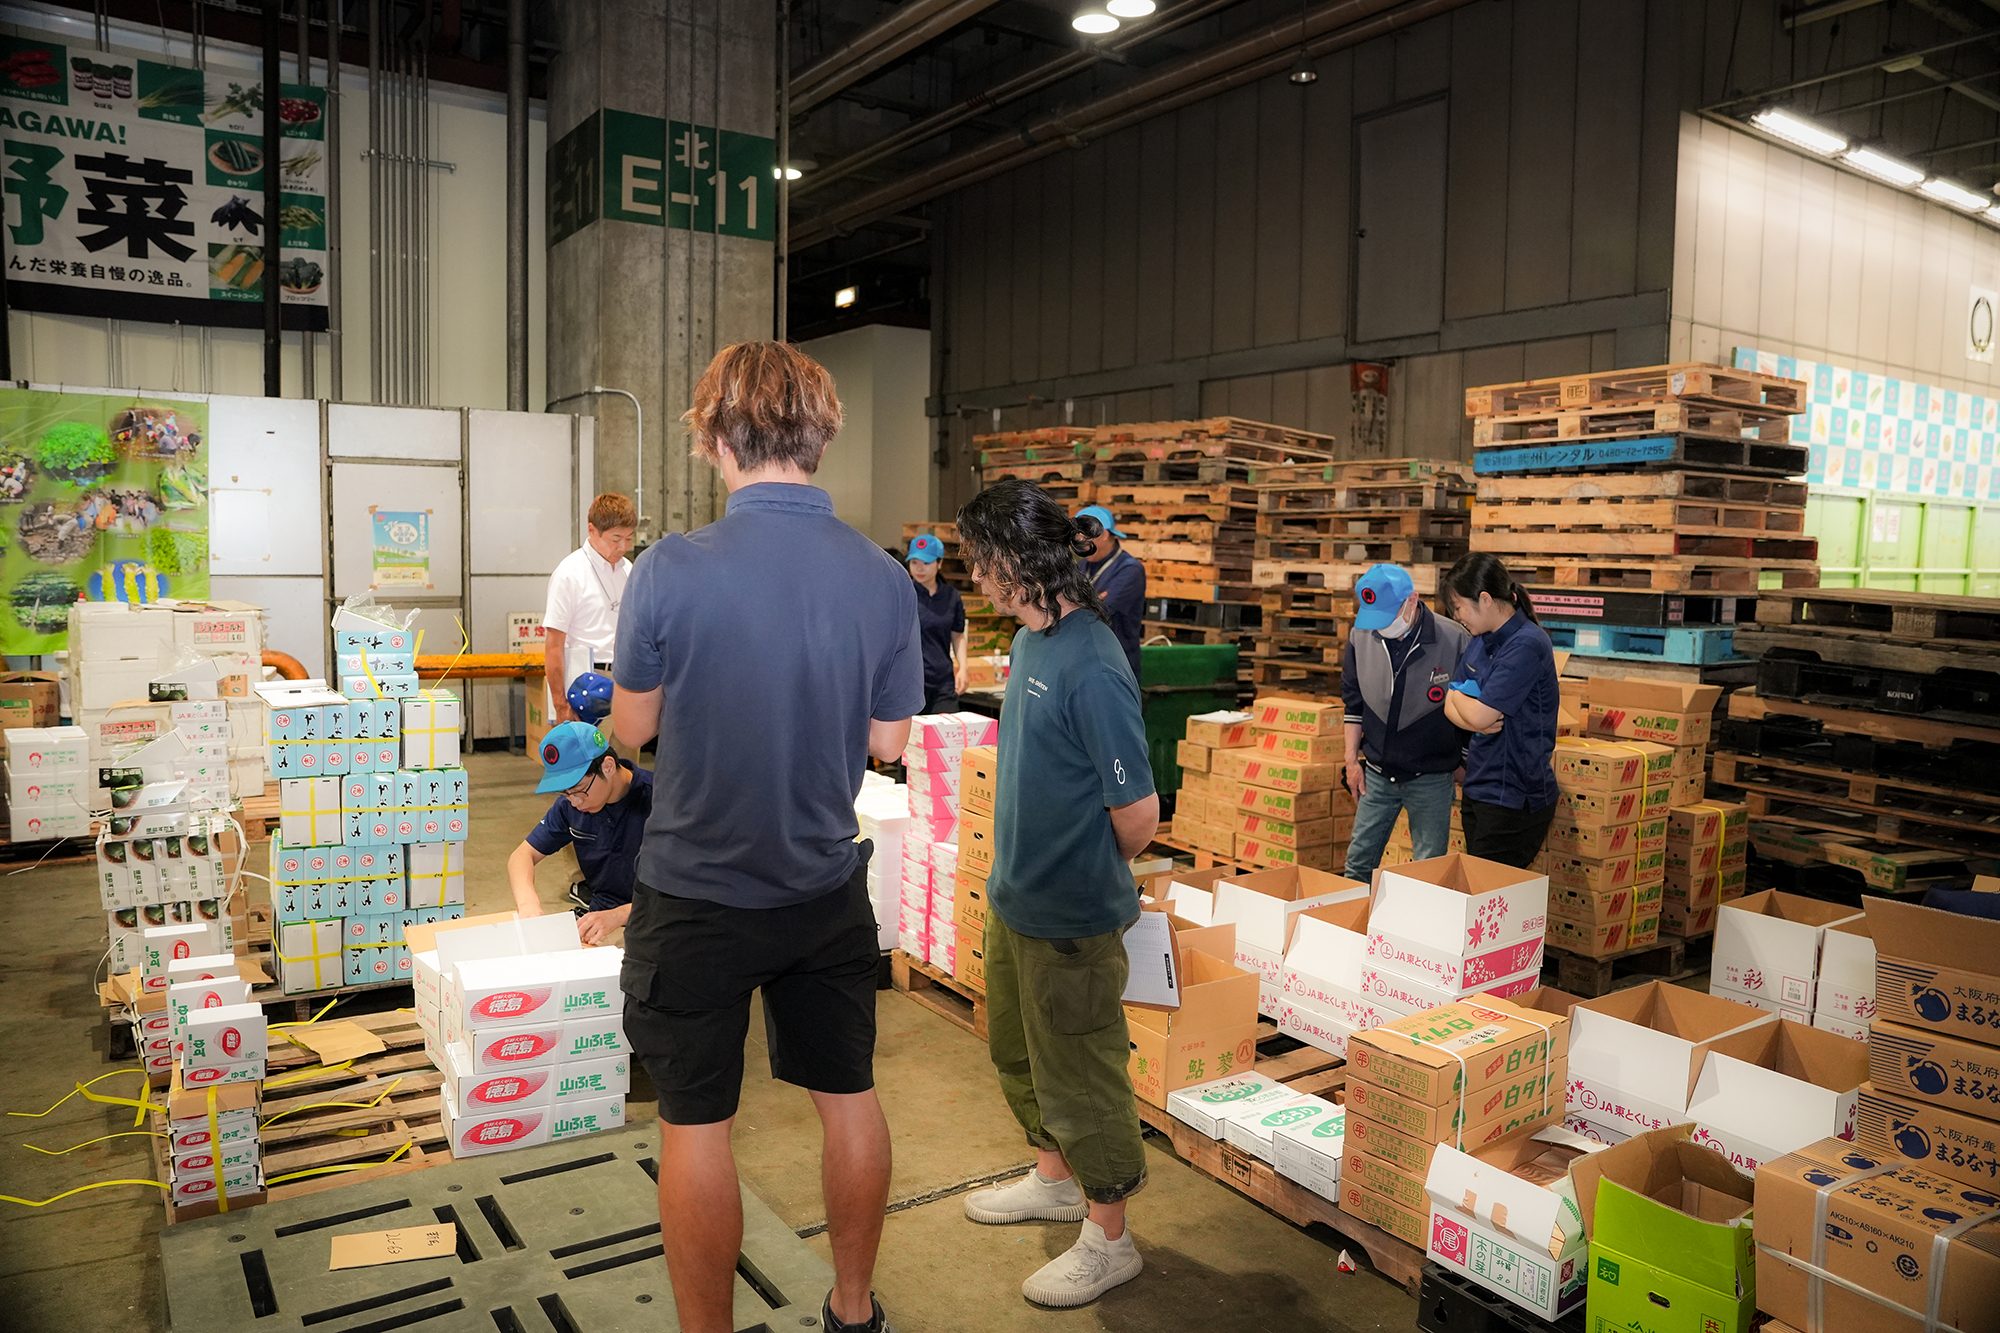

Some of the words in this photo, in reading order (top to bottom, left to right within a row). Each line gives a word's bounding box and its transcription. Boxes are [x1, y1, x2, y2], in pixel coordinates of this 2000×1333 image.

[675, 131, 709, 169] 北
[621, 154, 757, 230] E-11
[221, 291, 260, 299] スイートコーン
[518, 626, 546, 637] 禁煙
[347, 636, 383, 650] すだち
[369, 657, 405, 671] すだち
[377, 679, 409, 693] すだち
[944, 729, 979, 739] エシャット
[1234, 952, 1268, 969] A東とくしま
[1394, 950, 1443, 974] JA東とくしま
[1743, 968, 1763, 990] 彩
[489, 997, 523, 1014] 徳島
[1307, 988, 1348, 1010] JA東とくしま
[1388, 987, 1434, 1009] JA東とくしま
[1854, 996, 1876, 1019] 彩
[1303, 1023, 1343, 1045] JA東とくしま
[193, 1039, 206, 1057] ゆず
[500, 1040, 534, 1056] 徳島
[1505, 1036, 1557, 1074] 白ダツ
[231, 1070, 249, 1079] ゆず
[1355, 1050, 1369, 1068] 平
[1410, 1077, 1426, 1089] 2173
[1950, 1058, 2000, 1080] 大阪府
[485, 1081, 519, 1099] 徳島
[1504, 1071, 1556, 1109] 白ダツ
[1265, 1107, 1315, 1125] しろうり
[1353, 1086, 1367, 1103] 平
[1407, 1114, 1424, 1126] 2173
[1599, 1100, 1662, 1130] JA東とくしま
[480, 1123, 514, 1139] 徳島
[1315, 1117, 1341, 1136] しろ
[1352, 1121, 1367, 1139] 平
[1406, 1150, 1424, 1162] 2173
[1933, 1125, 1997, 1155] 大阪府産
[1935, 1143, 2000, 1178] まるなす
[1350, 1155, 1364, 1173] 平
[1403, 1186, 1420, 1198] 2173
[1882, 1170, 1952, 1195] まるなす
[1899, 1167, 1954, 1189] 阪府産
[1843, 1187, 1913, 1212] まるなす
[1348, 1190, 1362, 1207] 平
[1401, 1221, 1419, 1233] 2173
[1440, 1227, 1460, 1252] 尾
[1829, 1210, 1915, 1250] AK210×AS160×AK210
[1475, 1239, 1488, 1274] 木の芽
[1495, 1247, 1516, 1262] 数量
